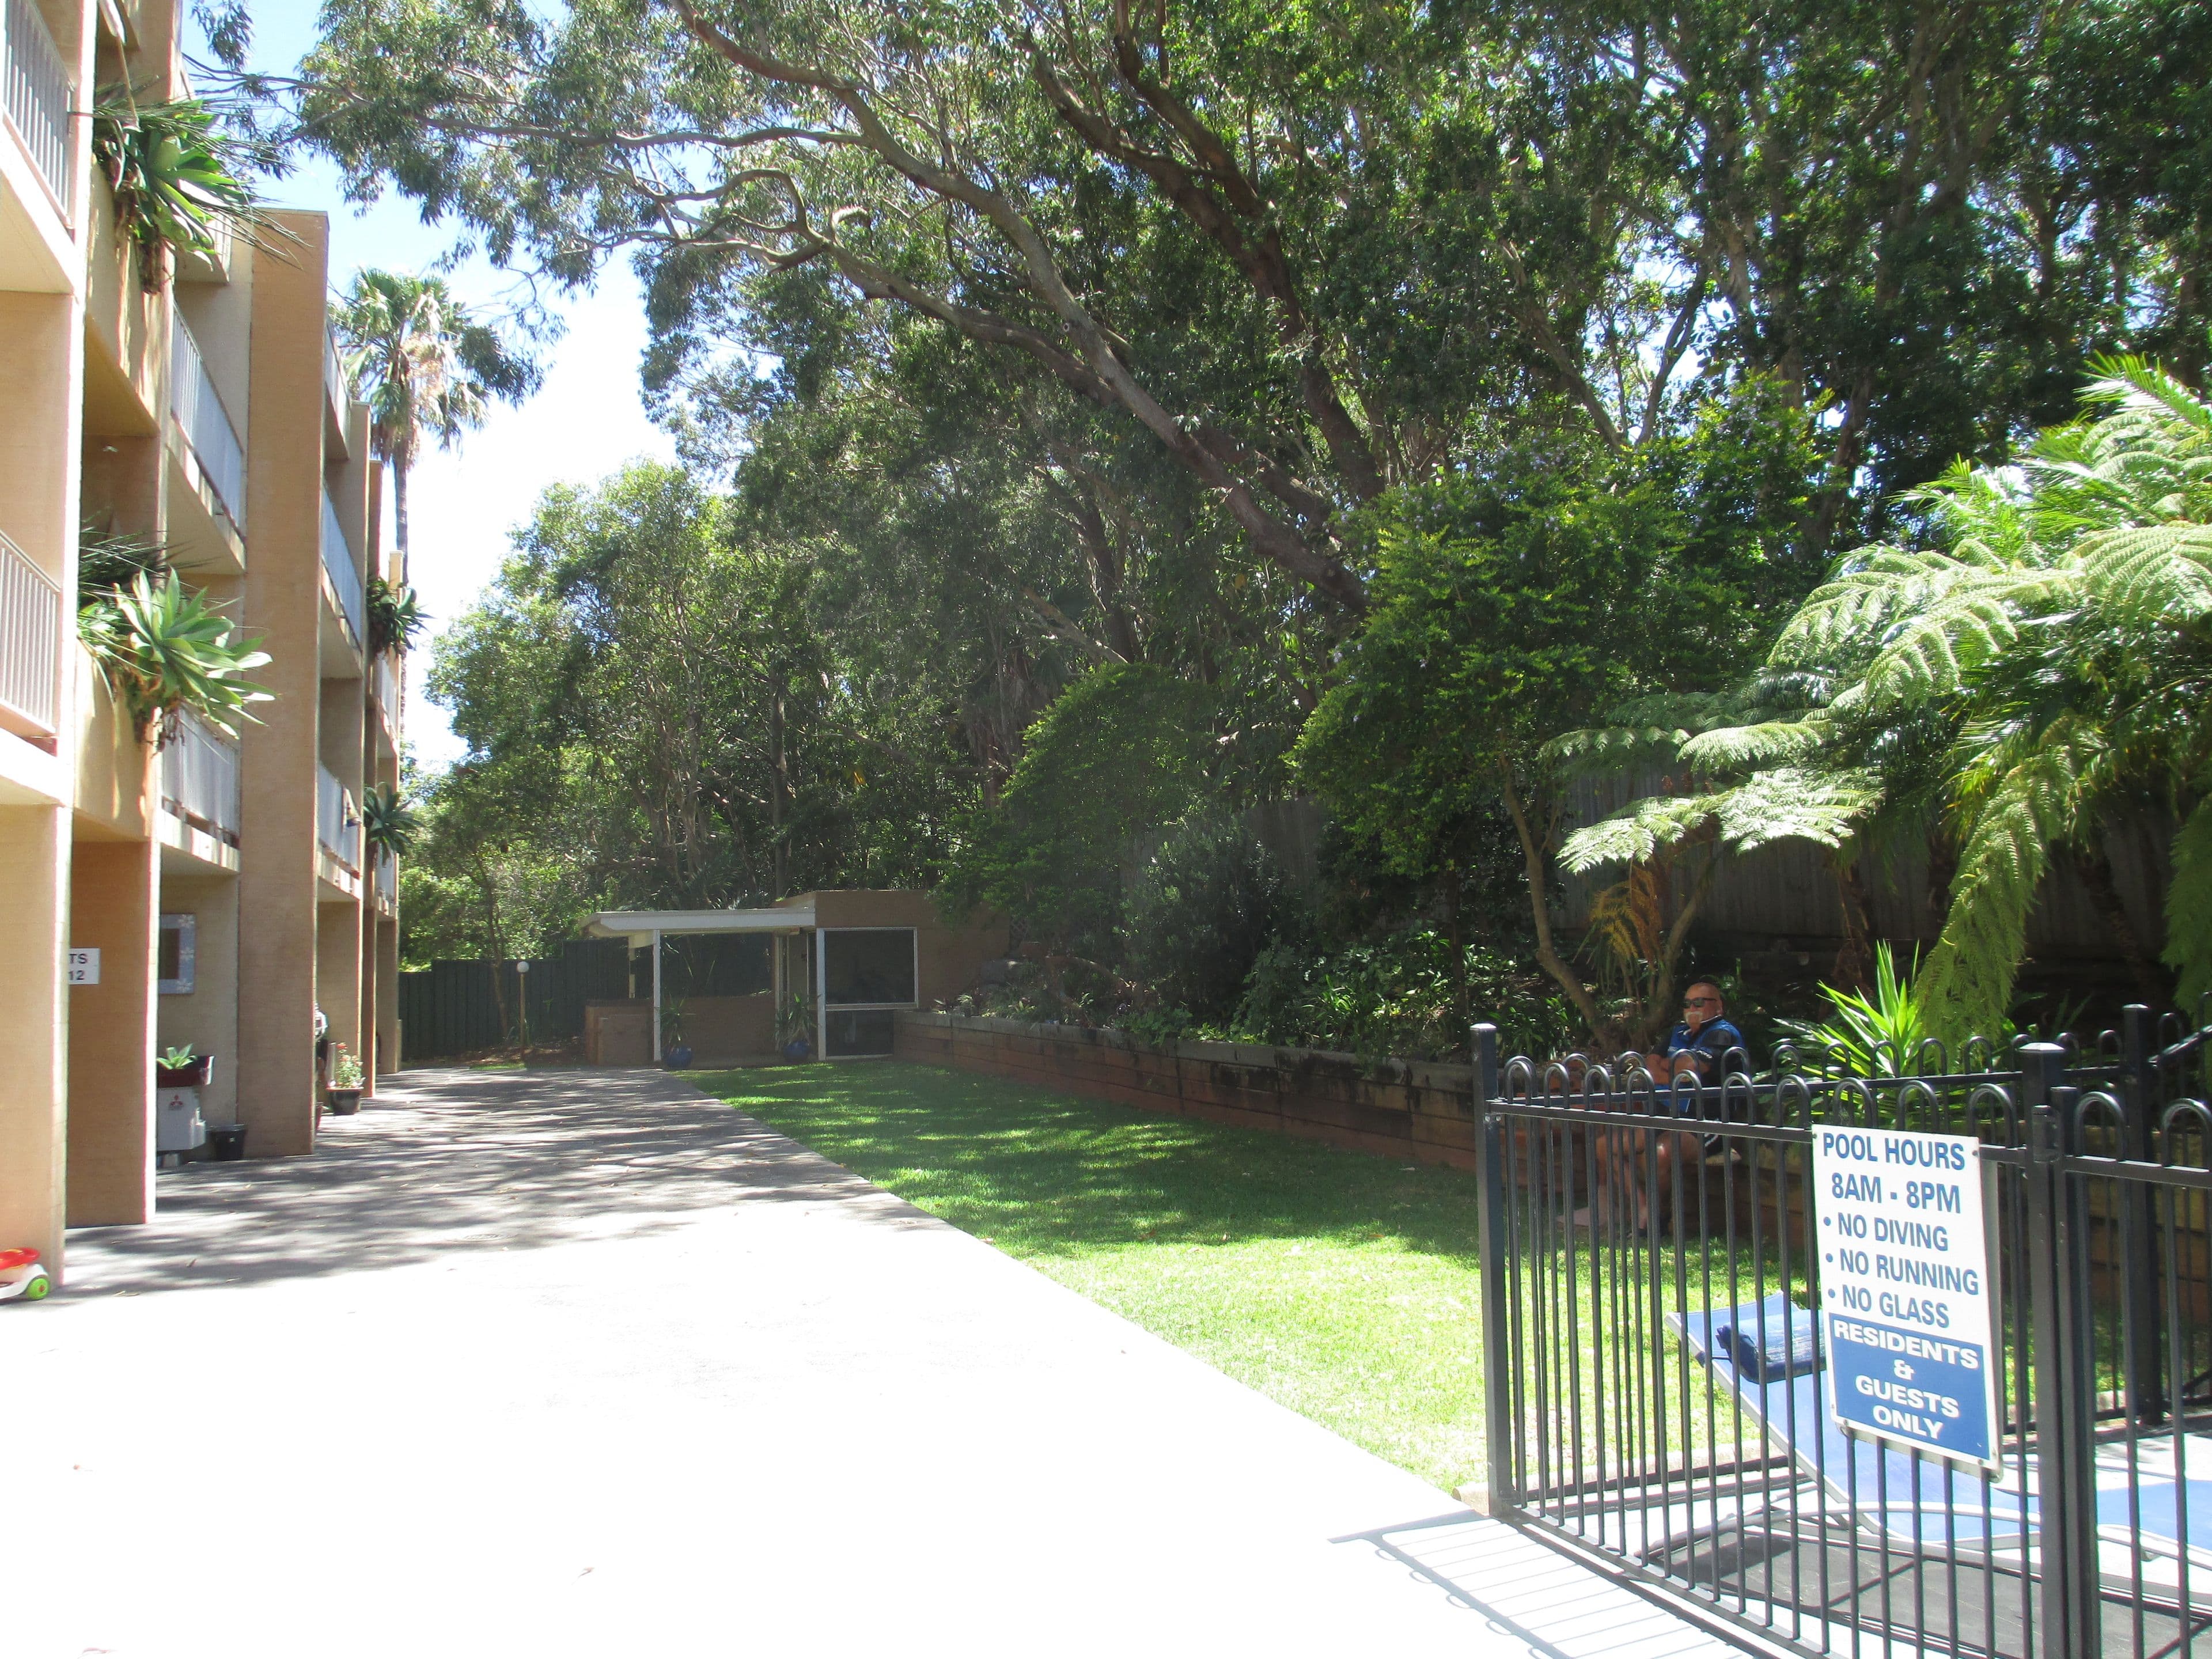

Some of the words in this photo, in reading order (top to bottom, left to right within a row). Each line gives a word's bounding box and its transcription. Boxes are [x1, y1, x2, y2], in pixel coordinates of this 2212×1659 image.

[1823, 1132, 1878, 1162] POOL
[1884, 1137, 1965, 1171] HOURS
[1831, 1172, 1883, 1204] 8AM
[1906, 1180, 1961, 1214] 8PM
[1838, 1212, 1868, 1238] NO
[1874, 1217, 1949, 1252] DIVING
[1840, 1248, 1870, 1275] NO
[1876, 1254, 1980, 1296] RUNNING
[1842, 1283, 1872, 1312] NO
[1879, 1291, 1950, 1328] GLASS
[1833, 1319, 1979, 1369] RESIDENTS
[1893, 1359, 1916, 1380] &
[1855, 1375, 1960, 1419] GUESTS
[1873, 1405, 1944, 1440] ONLY
